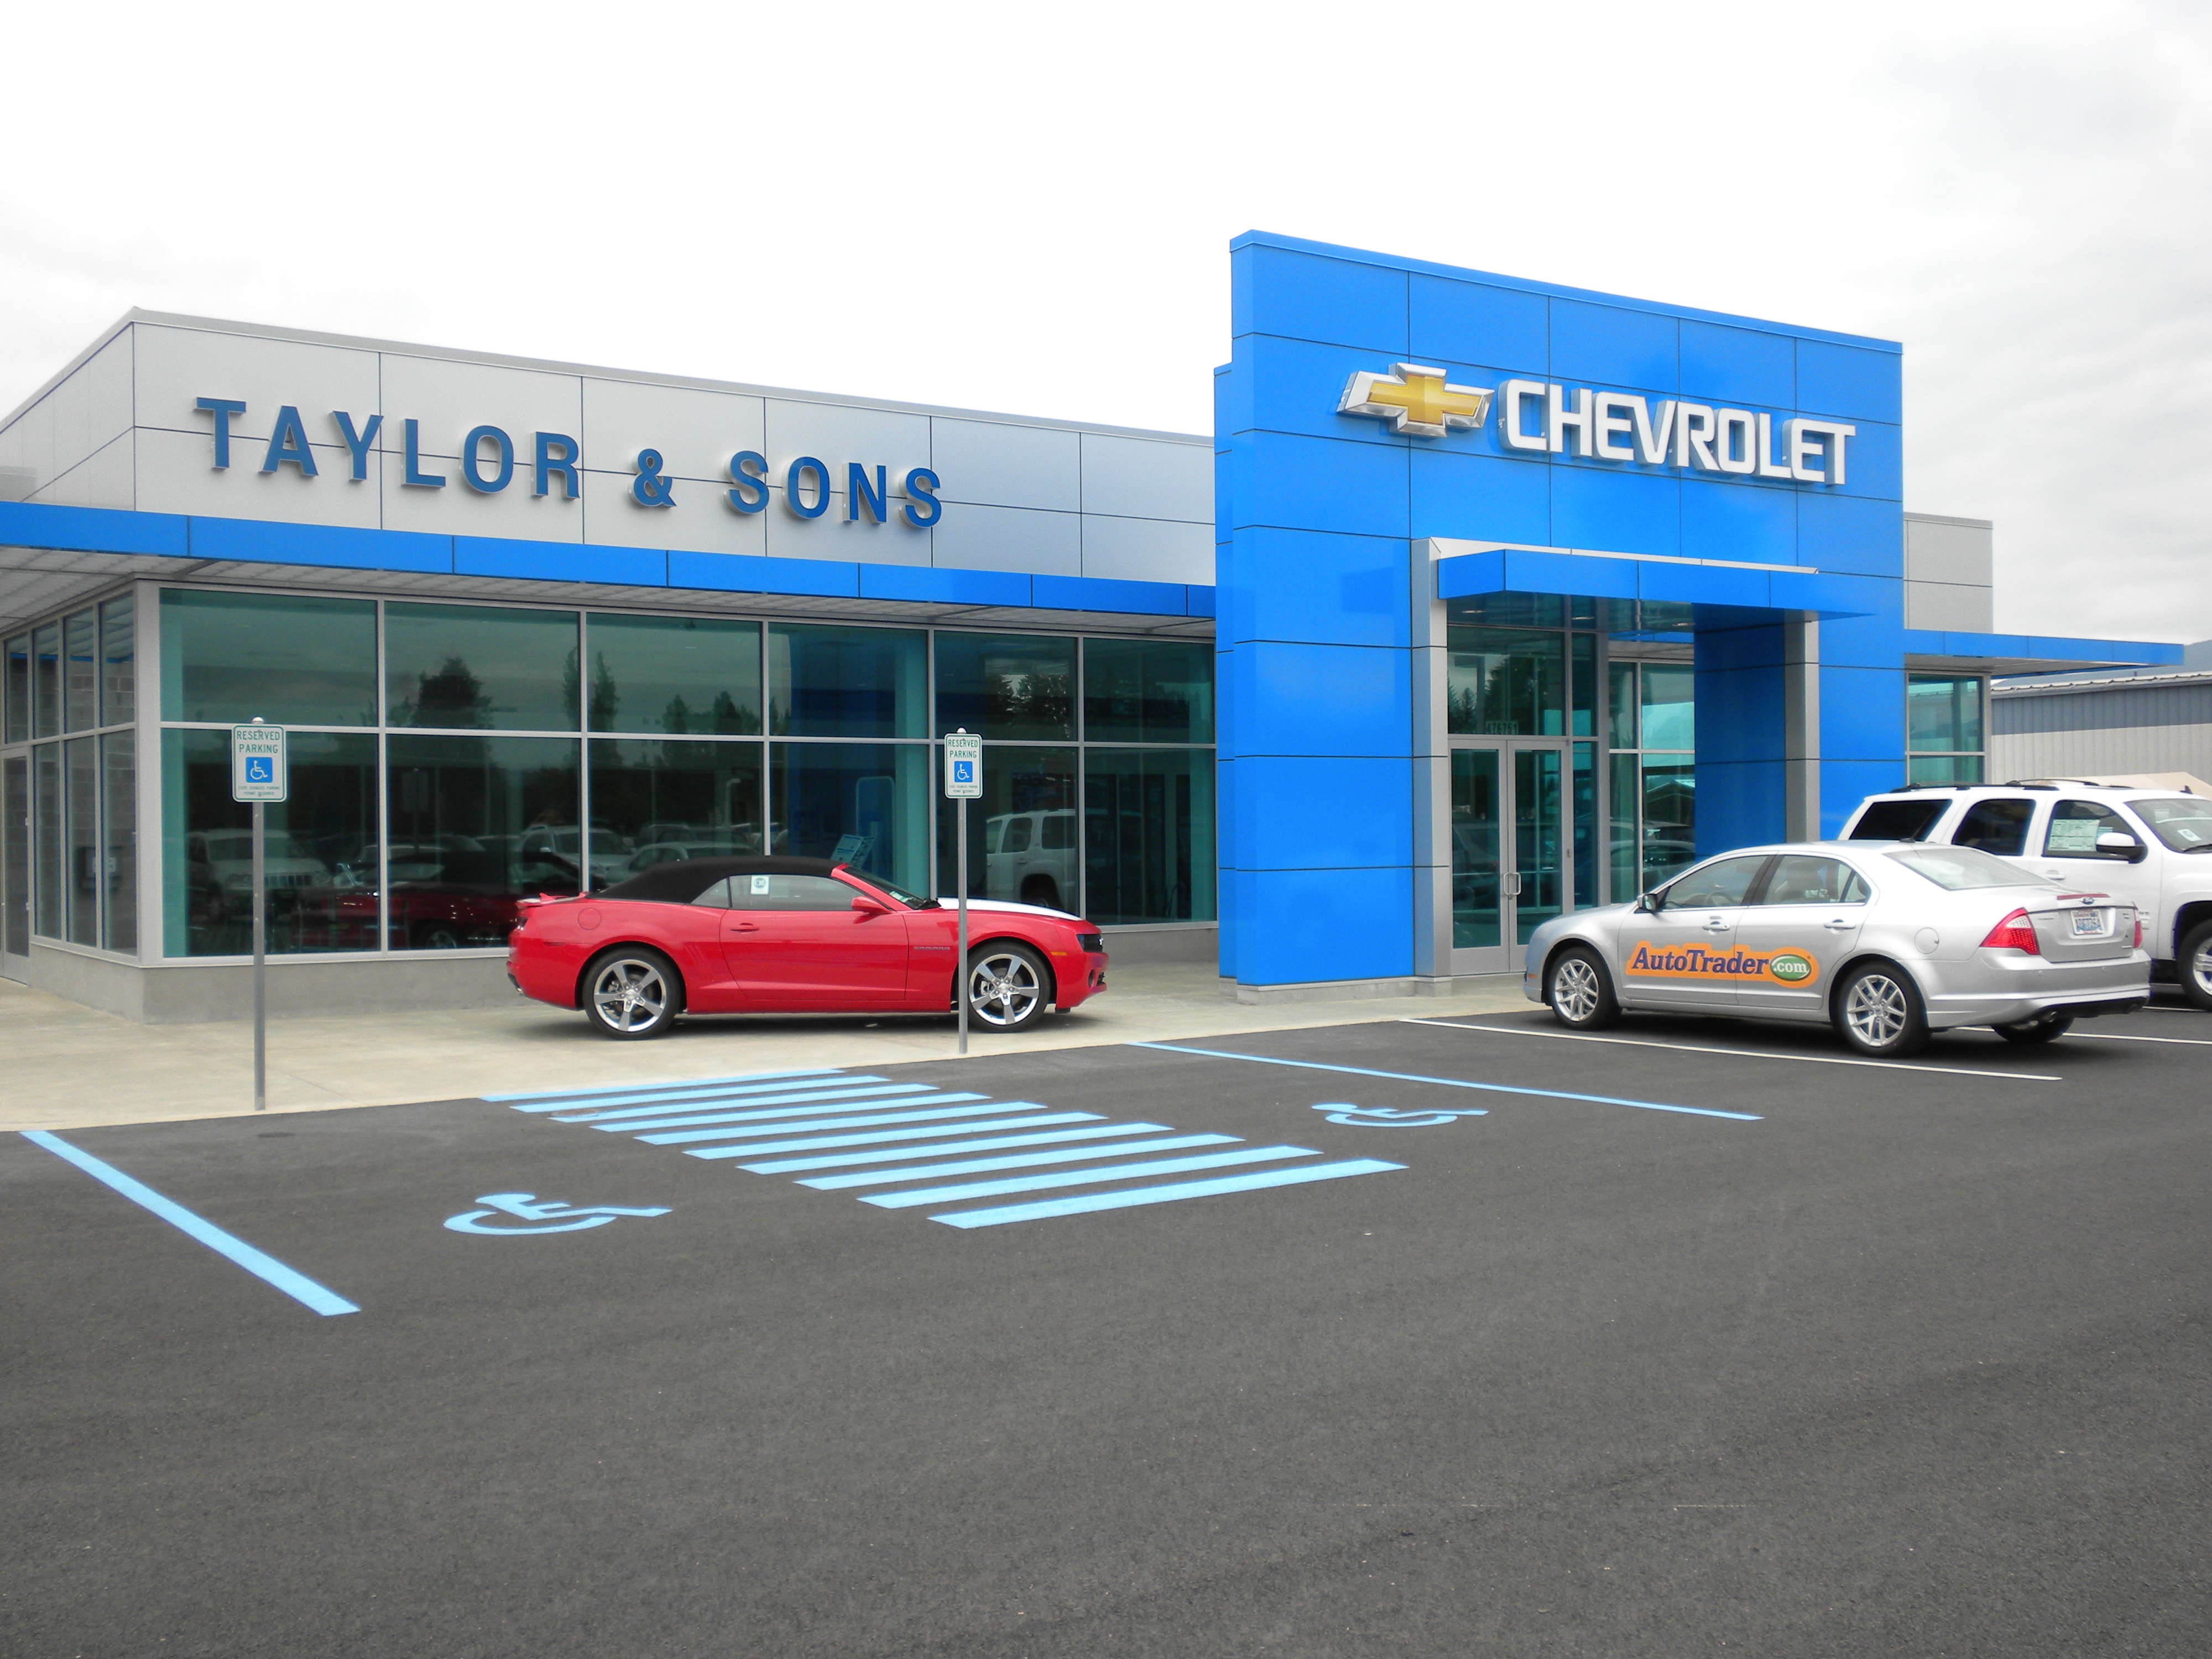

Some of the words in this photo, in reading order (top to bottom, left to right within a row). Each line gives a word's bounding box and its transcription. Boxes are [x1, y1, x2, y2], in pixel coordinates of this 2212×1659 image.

[1499, 378, 1856, 486] CHEVROLET
[194, 396, 580, 499] TAYLOR
[629, 448, 677, 508] &
[724, 450, 942, 528] SONS
[237, 731, 280, 740] RESERVED
[948, 739, 978, 748] RESERVED
[239, 744, 278, 754] PARKING
